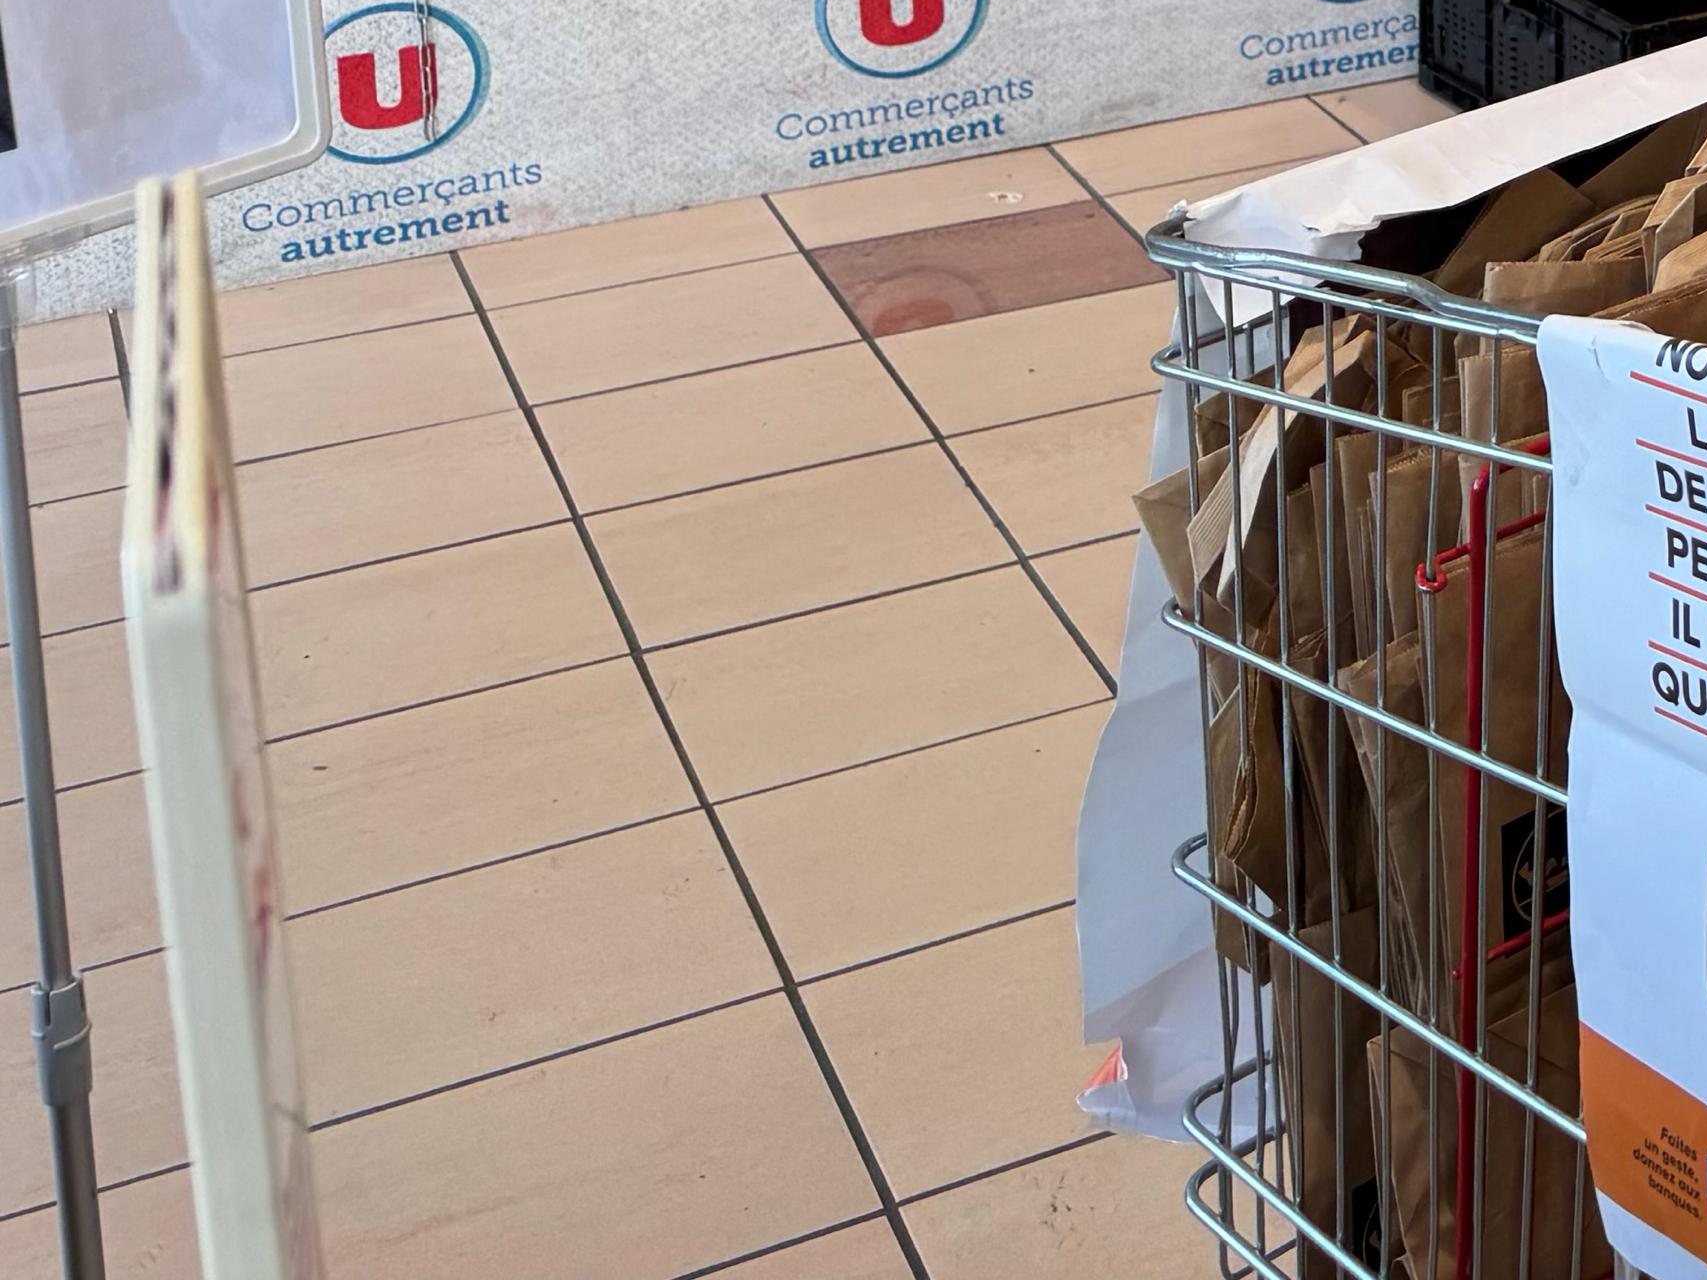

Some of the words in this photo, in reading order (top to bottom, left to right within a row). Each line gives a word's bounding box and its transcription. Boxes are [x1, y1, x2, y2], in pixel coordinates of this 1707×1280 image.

[1240, 14, 1419, 60] Commerça
[336, 42, 438, 130] U
[1266, 43, 1419, 86] autreme
[775, 76, 1035, 141] Commerçants
[808, 113, 1006, 171] autrement
[241, 162, 543, 233] Commerçants
[280, 199, 511, 264] autrement
[1671, 596, 1702, 649] IL
[1644, 1138, 1660, 1156] un
[1660, 1126, 1697, 1162] Faites
[1632, 1147, 1676, 1185] donnez
[1678, 1179, 1701, 1201] aux
